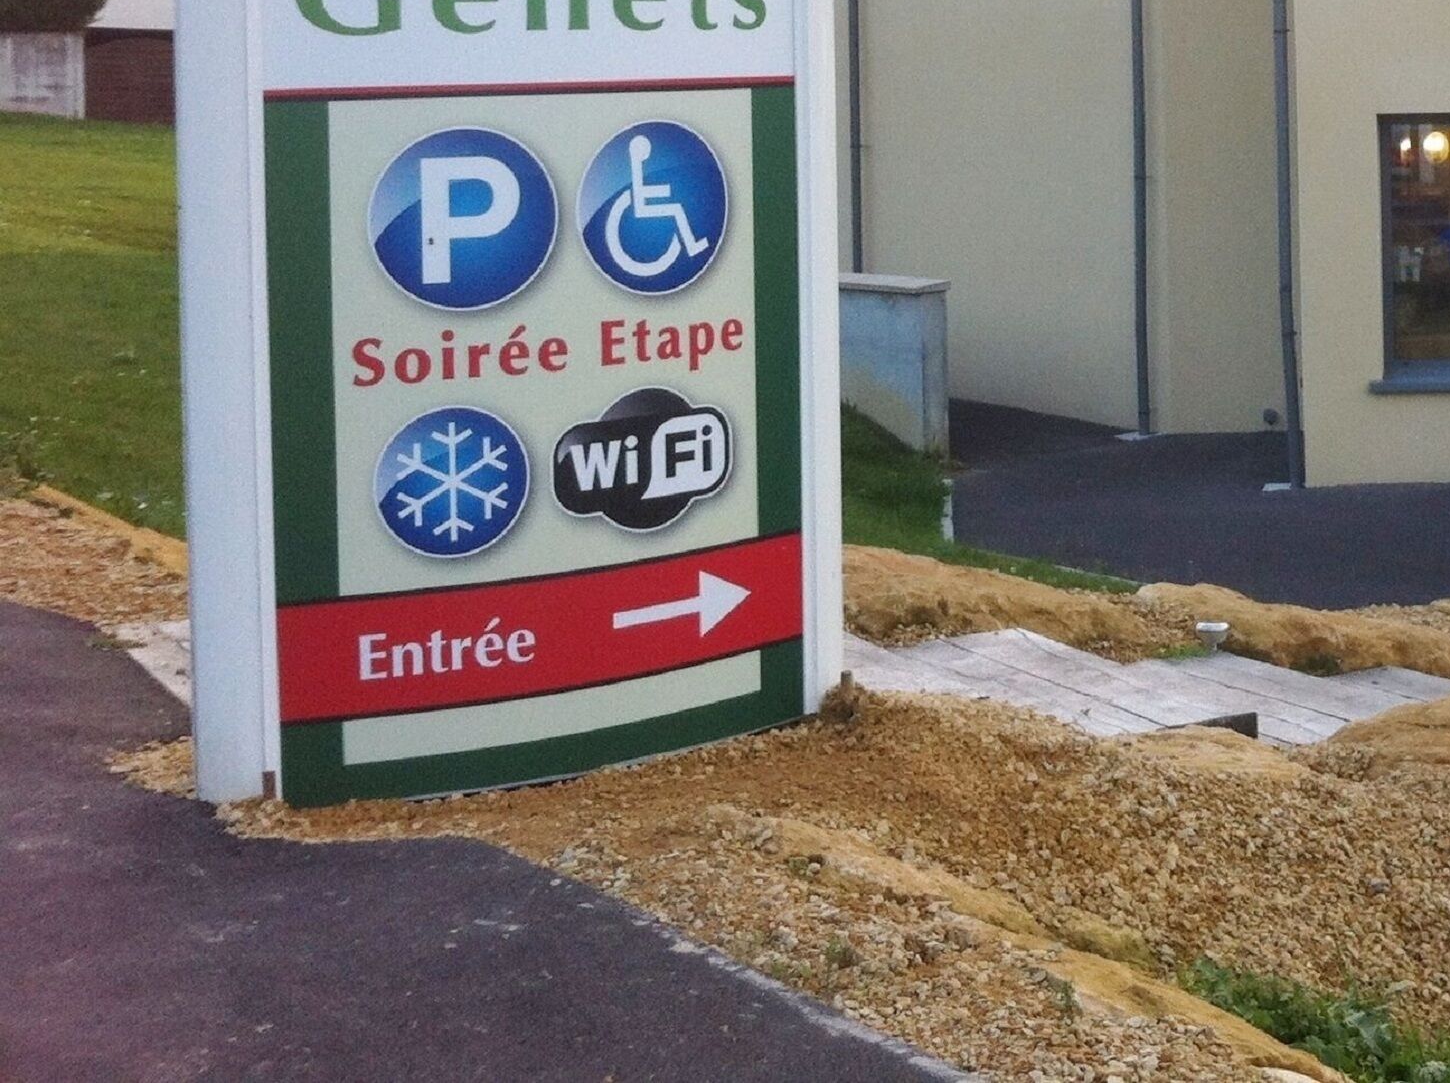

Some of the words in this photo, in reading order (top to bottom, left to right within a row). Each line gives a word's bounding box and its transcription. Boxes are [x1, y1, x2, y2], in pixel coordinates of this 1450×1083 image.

[420, 156, 520, 284] P
[351, 325, 569, 386] Soirée
[600, 316, 745, 371] Etape
[357, 617, 536, 681] Entrée
